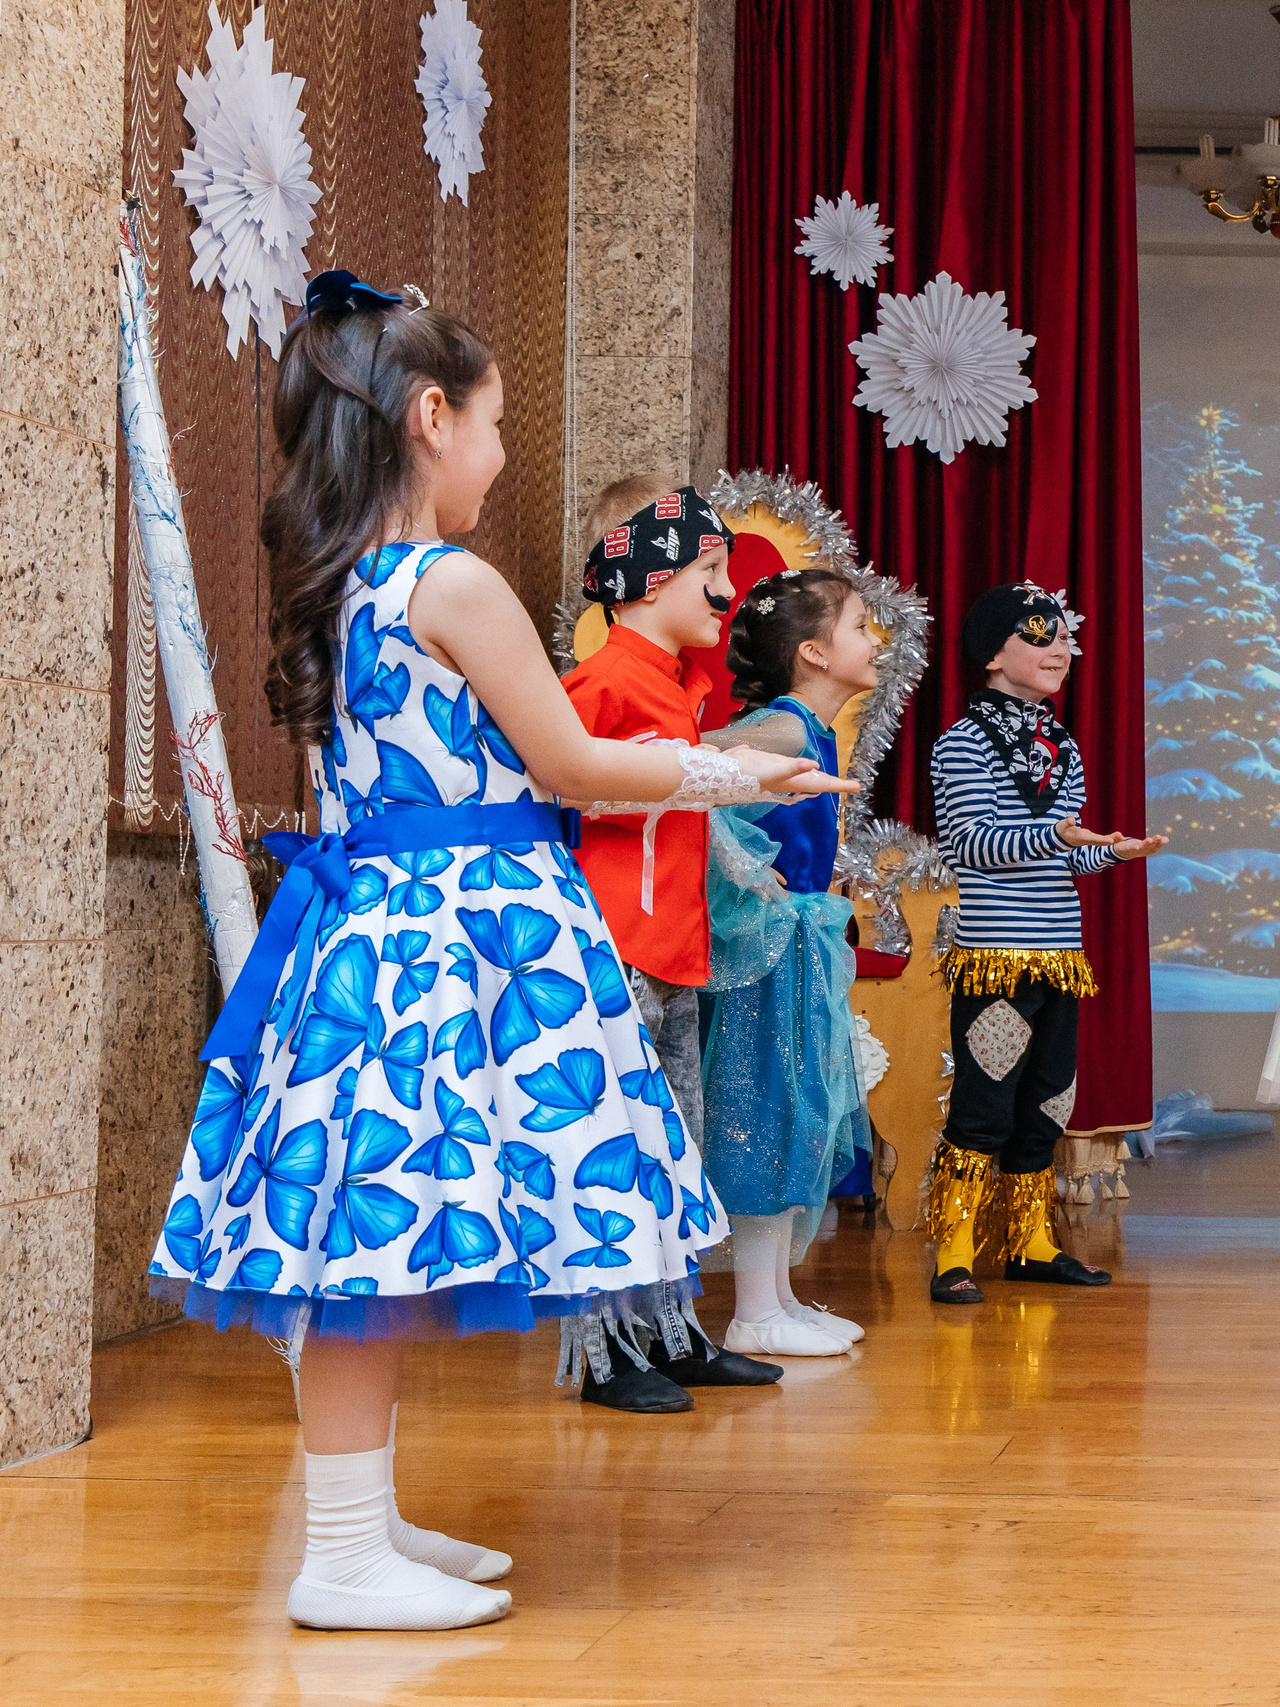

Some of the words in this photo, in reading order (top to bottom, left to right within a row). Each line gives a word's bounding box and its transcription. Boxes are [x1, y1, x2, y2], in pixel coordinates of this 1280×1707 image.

[655, 493, 681, 519] 88
[604, 526, 630, 558] 88
[698, 535, 724, 557] 8
[646, 570, 673, 595] 8
